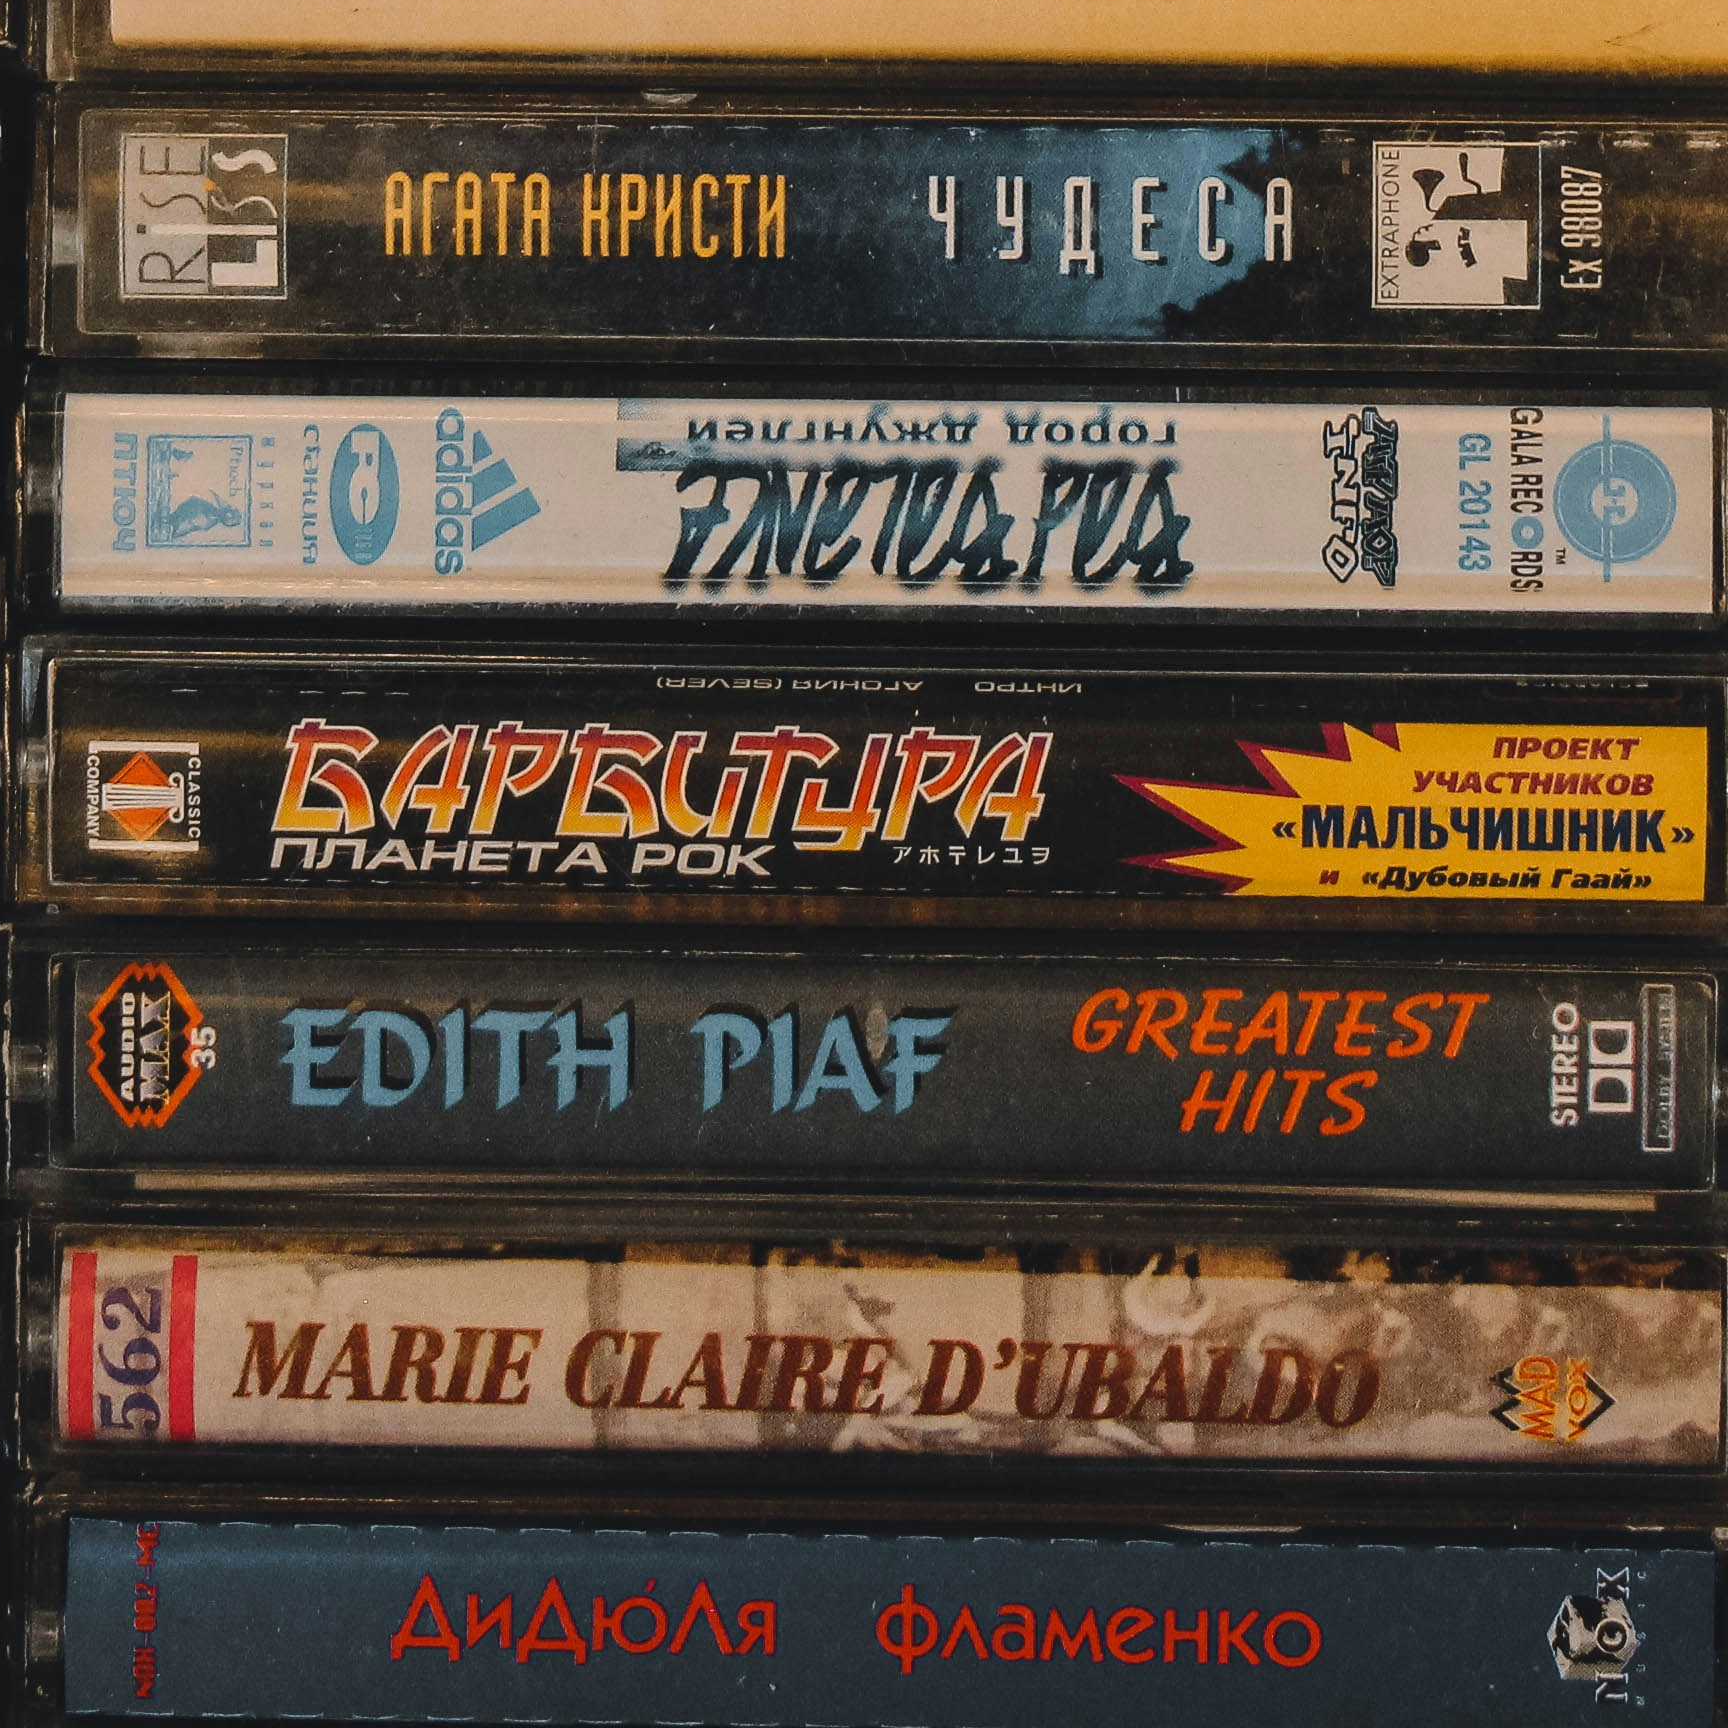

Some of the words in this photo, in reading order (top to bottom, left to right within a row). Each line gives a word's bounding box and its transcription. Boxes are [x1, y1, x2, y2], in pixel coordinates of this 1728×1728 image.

[385, 171, 551, 257] АГАТА
[580, 173, 787, 259] КРИСТИ
[929, 176, 1293, 276] ЧУДЕСА
[1381, 150, 1400, 301] EXTRAPHONE
[1560, 166, 1602, 248] 98087
[1560, 254, 1602, 290] Ex
[1458, 434, 1491, 472] GL
[1509, 408, 1542, 468] GALA
[435, 406, 463, 575] adidas
[1458, 477, 1491, 572] 20143
[792, 679, 922, 693] АГОНИЯ
[975, 682, 1082, 695] ИНТРО
[272, 718, 1052, 852] БАРБИТУРА
[1412, 771, 1655, 797] УЧАСТНИКОВ
[1492, 736, 1639, 761] ПРОЕКТ
[86, 758, 100, 839] COMPANY
[187, 757, 202, 840] CLASSIC
[1272, 805, 1695, 854] «МАЛЬЧИШНИК»
[271, 838, 606, 874] ПЛАНЕТА
[632, 843, 775, 877] РОК
[1319, 869, 1340, 886] и
[1362, 864, 1539, 892] «Дубовый
[1549, 866, 1653, 892] Гаай»
[120, 991, 135, 1103] AUDIO
[138, 990, 172, 1106] MAX
[191, 1025, 216, 1070] 35
[279, 1007, 634, 1112] EDITH
[691, 1007, 954, 1114] PIAF
[1073, 988, 1490, 1060] GREATEST
[1551, 1002, 1579, 1127] STEREO
[1180, 1071, 1379, 1137] HITS
[100, 1284, 162, 1434] 562
[232, 1320, 542, 1404] MARIE
[564, 1330, 897, 1413] CLAIRE
[1516, 1356, 1555, 1441] MAD
[1567, 1358, 1590, 1443] VOX
